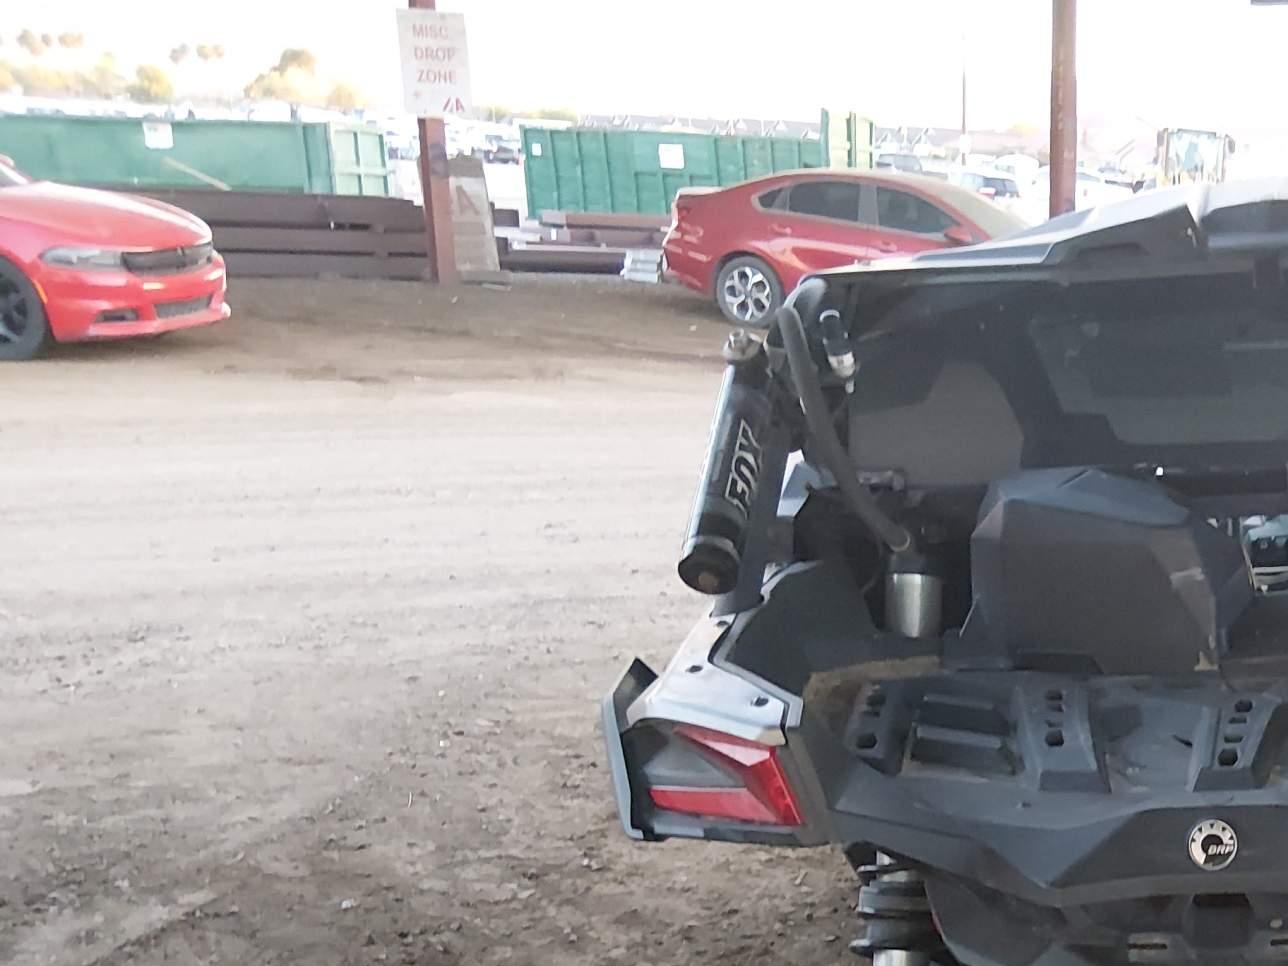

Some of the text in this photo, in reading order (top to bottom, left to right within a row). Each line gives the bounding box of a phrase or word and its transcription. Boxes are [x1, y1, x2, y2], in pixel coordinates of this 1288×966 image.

[414, 46, 456, 62] DROP
[417, 69, 457, 85] ZONE
[725, 418, 764, 520] FOX
